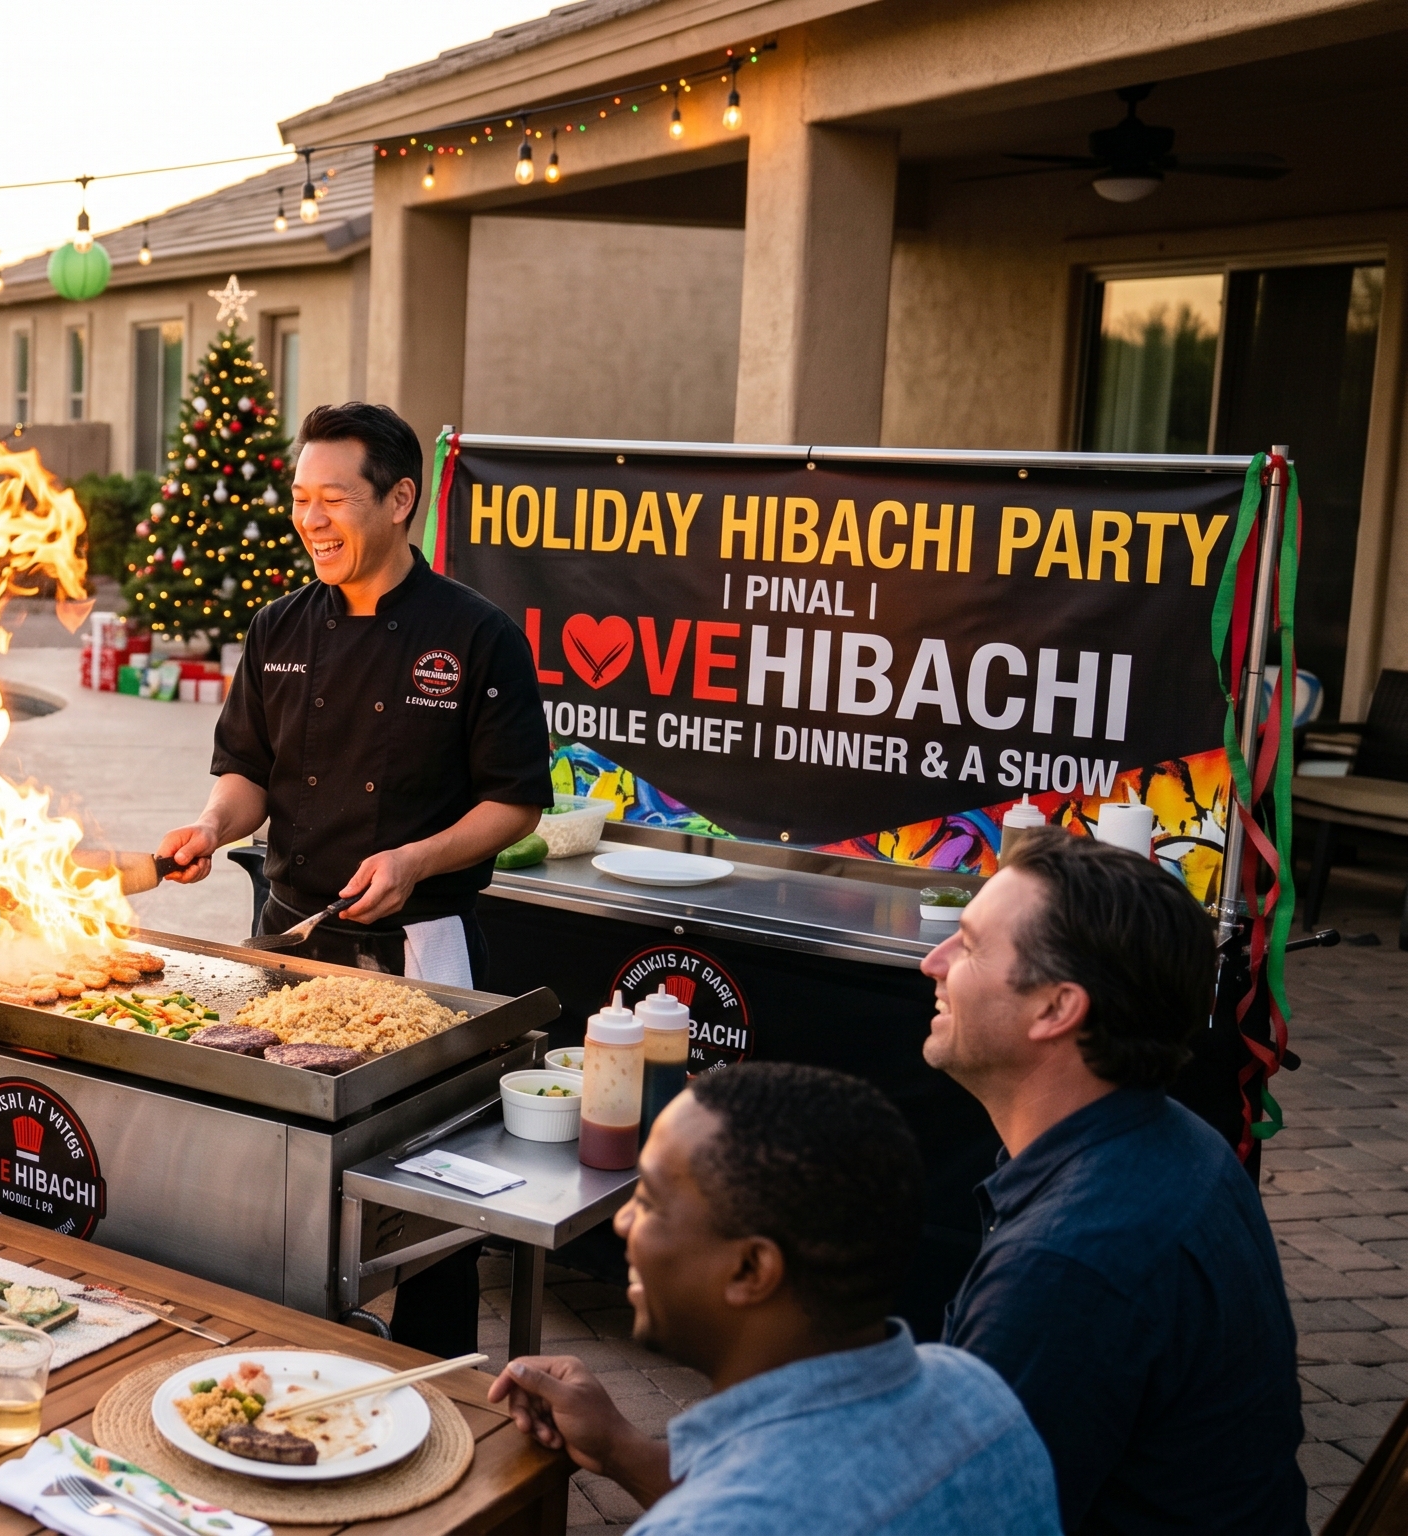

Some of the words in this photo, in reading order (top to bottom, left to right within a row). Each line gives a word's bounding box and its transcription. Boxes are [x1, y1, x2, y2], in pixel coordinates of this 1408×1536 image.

[469, 483, 703, 557] HOLIDAY
[719, 494, 975, 573] HIBACHI
[997, 506, 1230, 587] PARTY
[744, 574, 855, 618] PINAL
[657, 712, 744, 755] CHEF
[774, 724, 908, 775] DINNER
[920, 740, 949, 779] &
[958, 745, 986, 784] A
[997, 748, 1119, 798] SHOW
[680, 955, 700, 973] AT
[688, 1019, 747, 1050] BACHI
[28, 1095, 46, 1115] AT
[15, 1162, 96, 1208] HIBACHI
